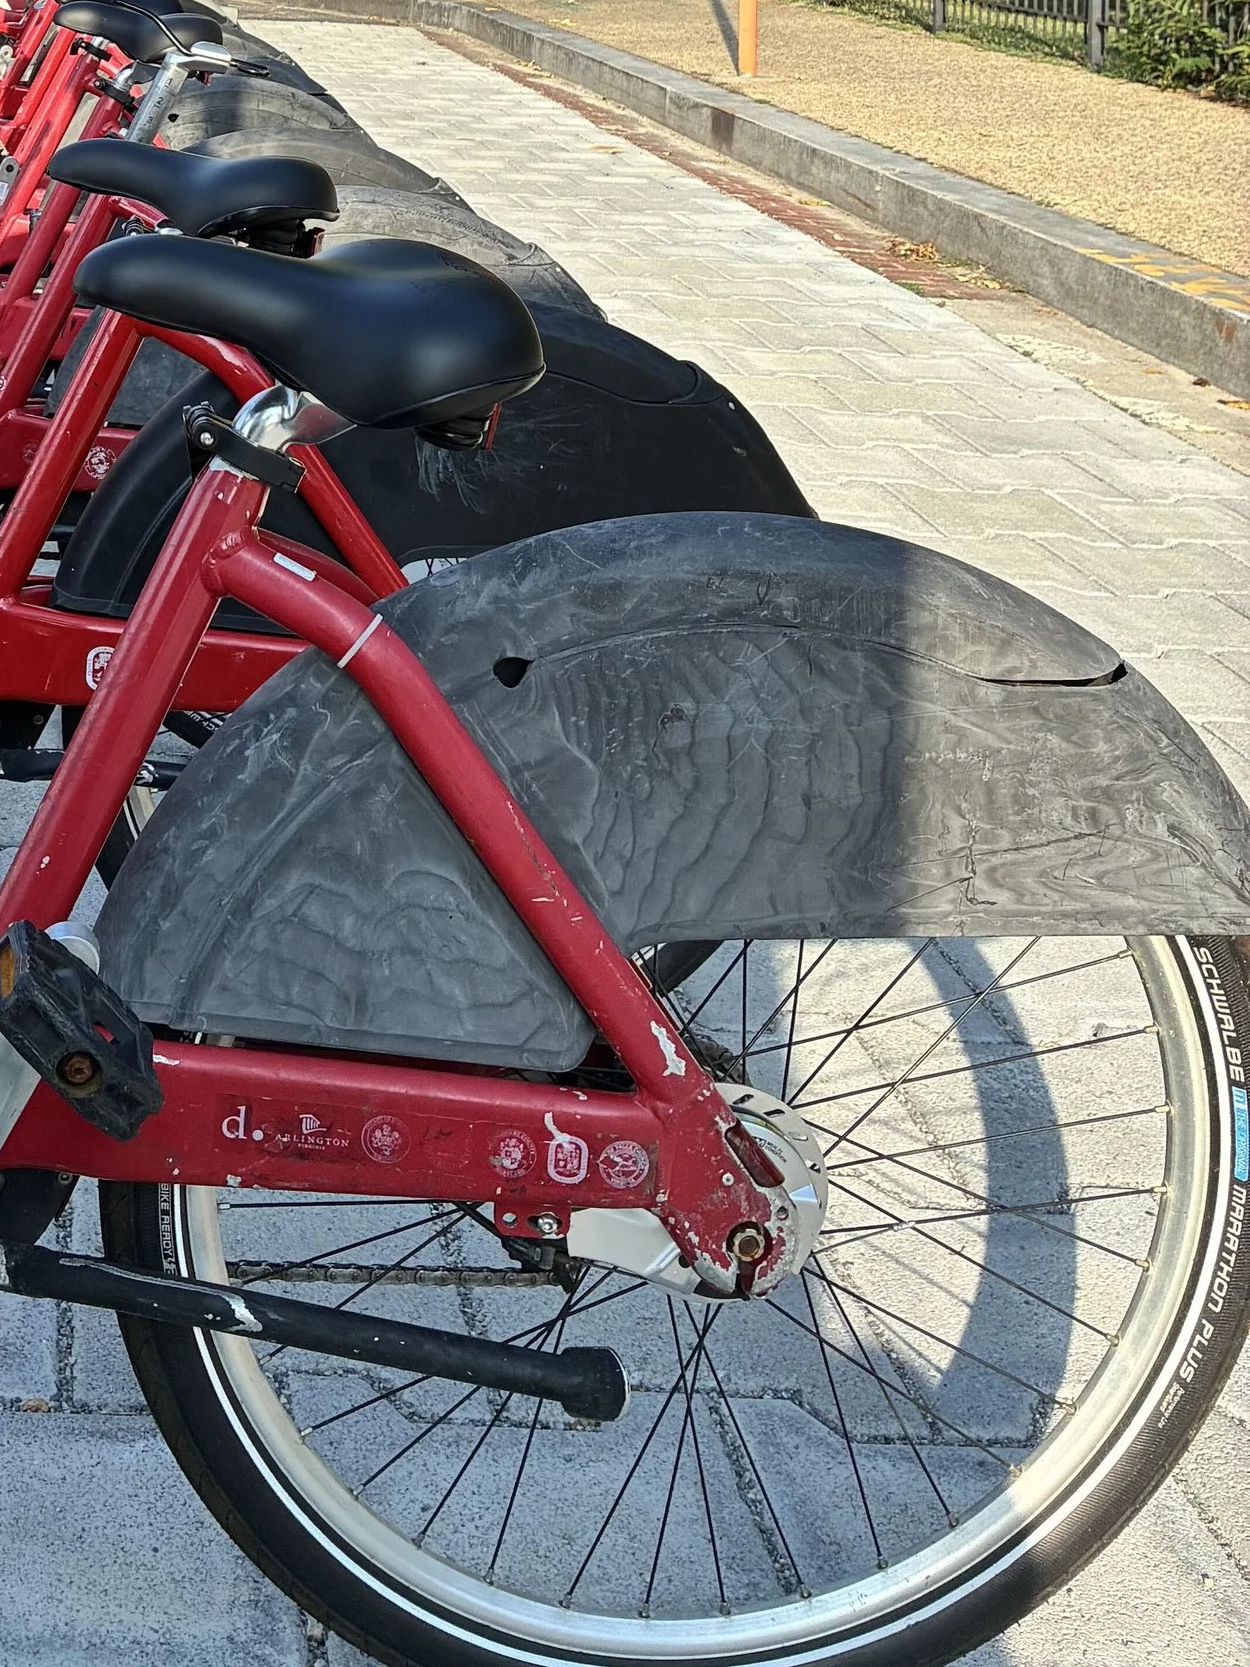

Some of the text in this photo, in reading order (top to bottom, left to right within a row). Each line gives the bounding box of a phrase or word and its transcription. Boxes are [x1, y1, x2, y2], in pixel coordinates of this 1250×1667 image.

[1193, 946, 1246, 1083] SCHWALBE
[275, 1133, 350, 1148] ARLINGTON
[160, 1183, 174, 1256] BIKE READY
[1208, 1184, 1247, 1313] MARATHON
[1179, 1318, 1215, 1383] PLUS
